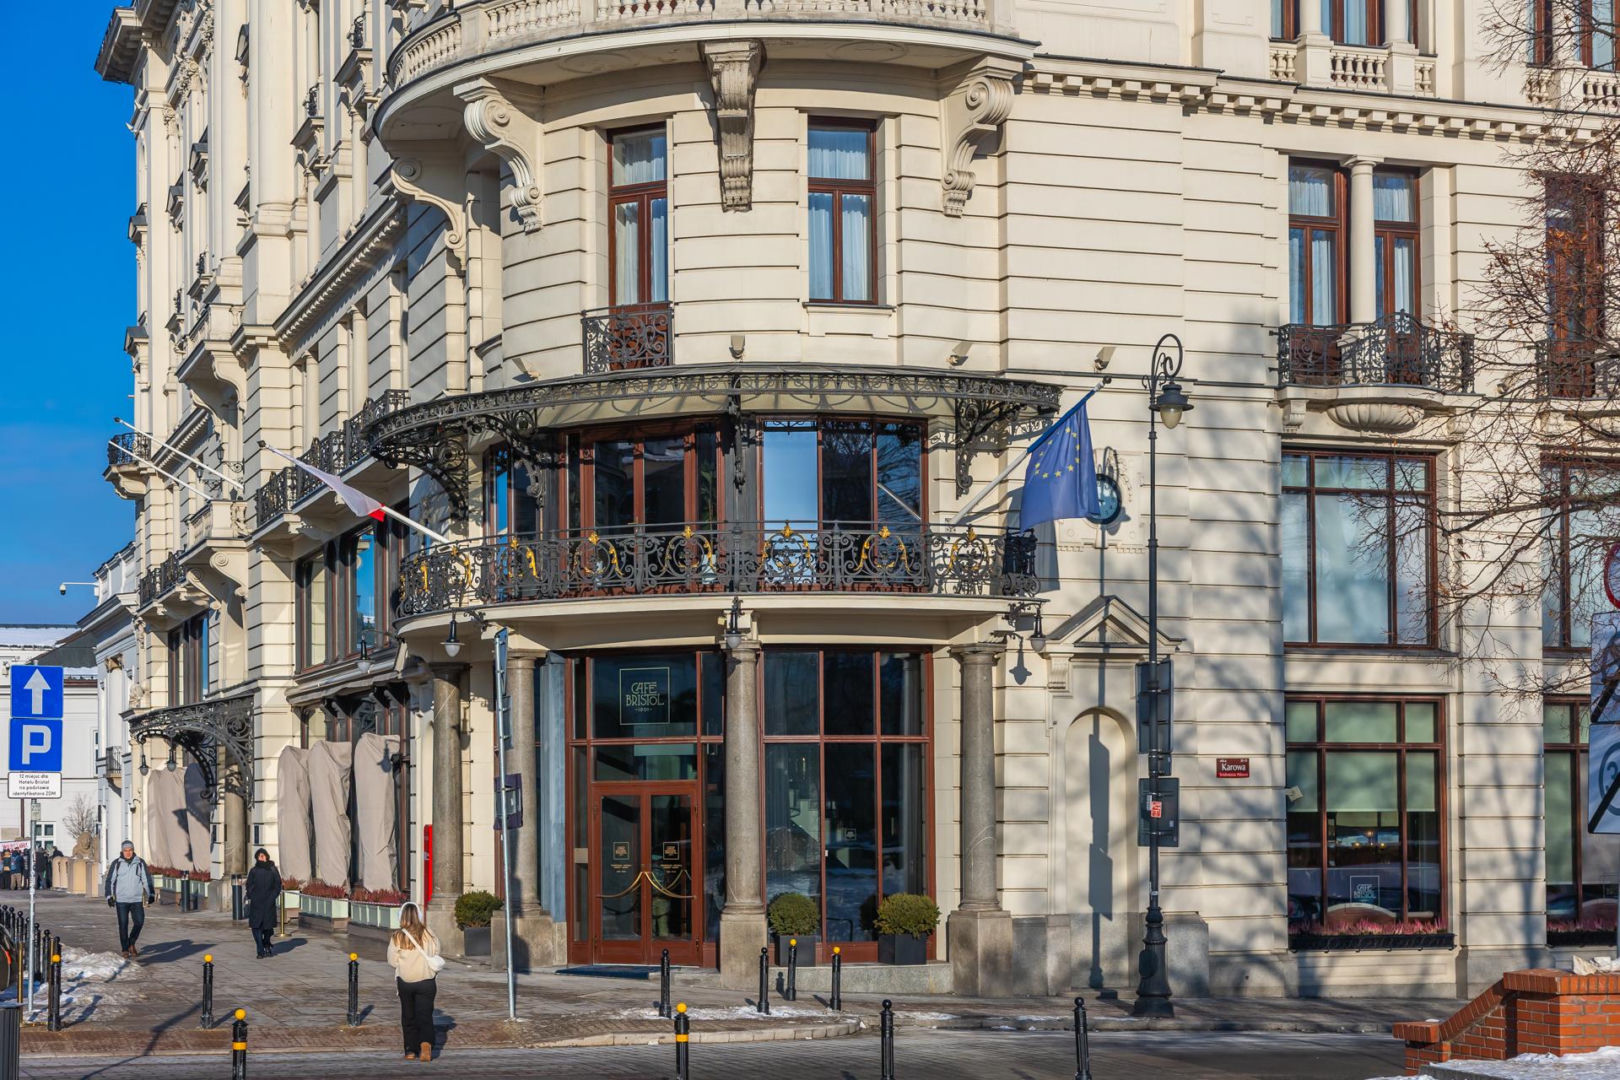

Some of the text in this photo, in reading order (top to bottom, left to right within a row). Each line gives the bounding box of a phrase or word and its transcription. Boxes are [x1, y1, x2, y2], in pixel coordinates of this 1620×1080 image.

[631, 681, 657, 694] CAFE
[625, 693, 665, 706] BRISTOL
[22, 724, 52, 765] P
[1222, 763, 1246, 771] Karowa
